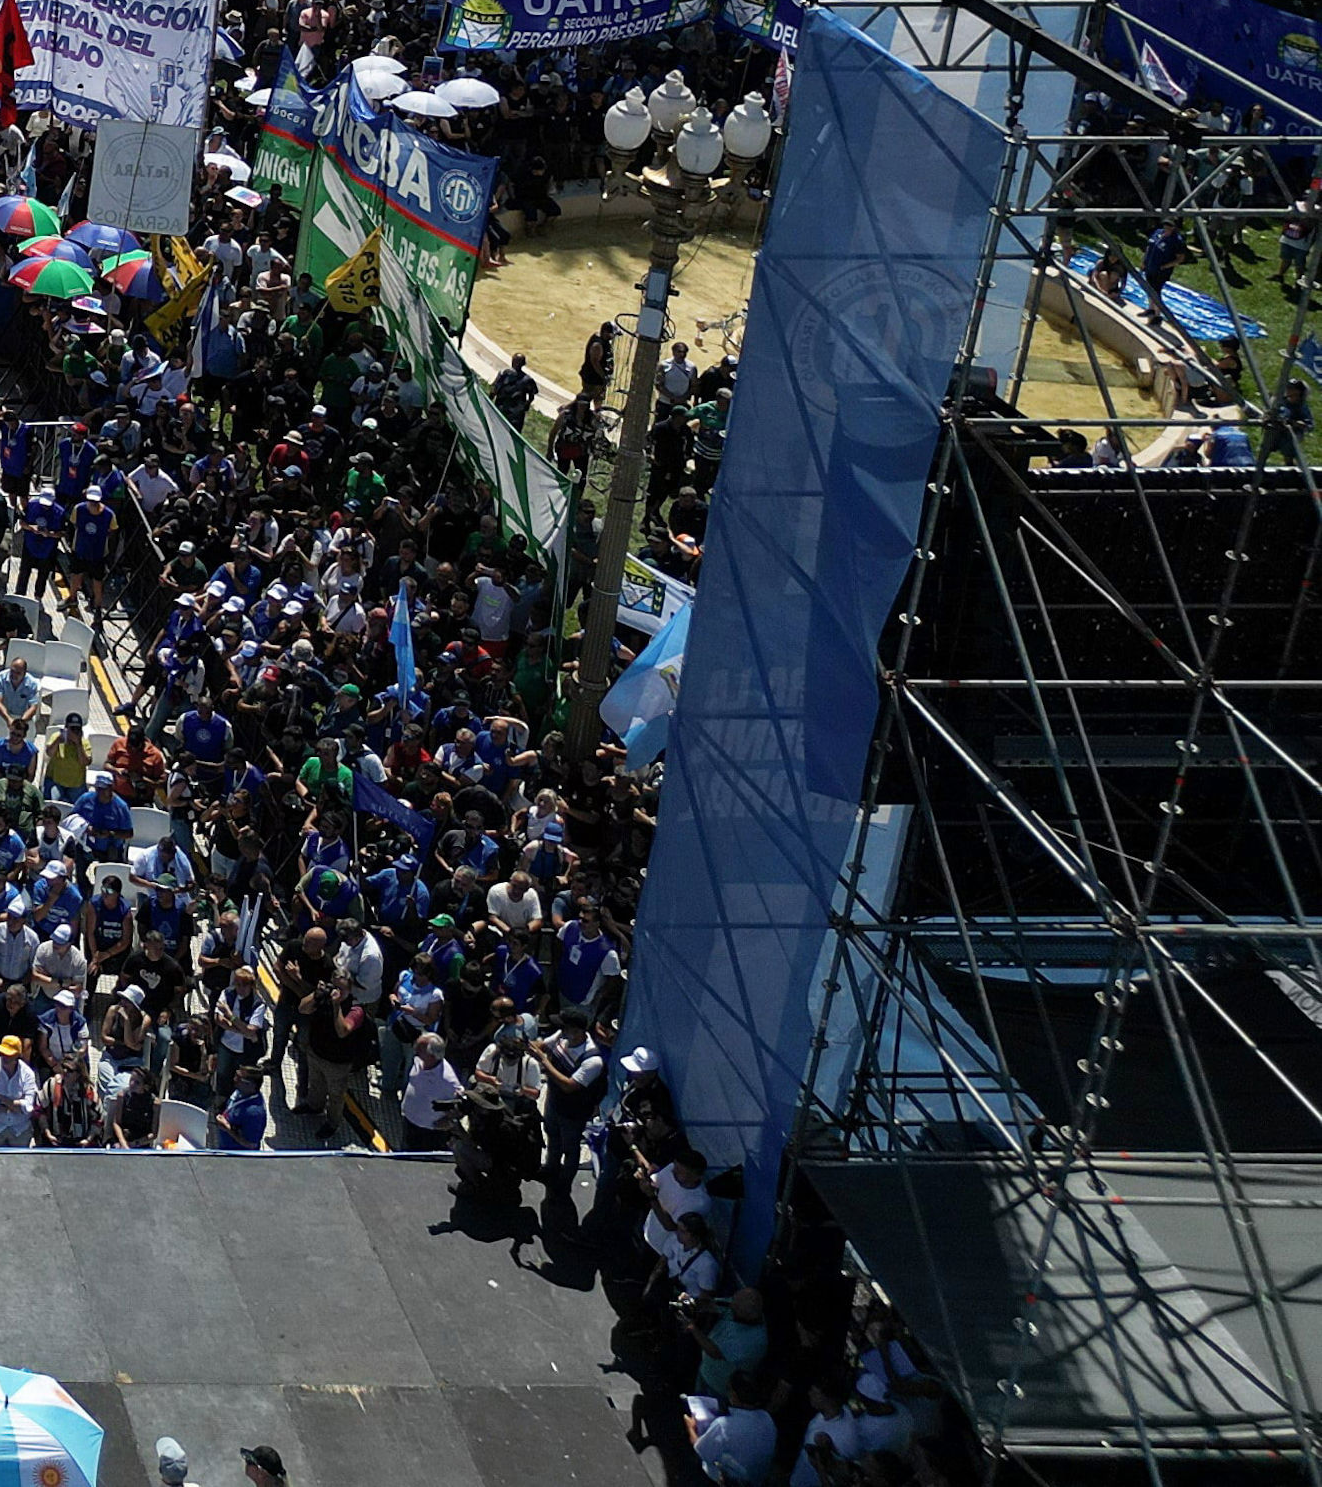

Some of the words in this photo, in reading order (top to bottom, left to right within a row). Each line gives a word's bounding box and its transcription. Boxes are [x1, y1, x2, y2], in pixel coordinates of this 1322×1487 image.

[507, 26, 597, 49] PERGAMINO
[599, 14, 667, 44] PRESENTE
[564, 15, 612, 29] SECCIONAL
[106, 24, 155, 58] DEL
